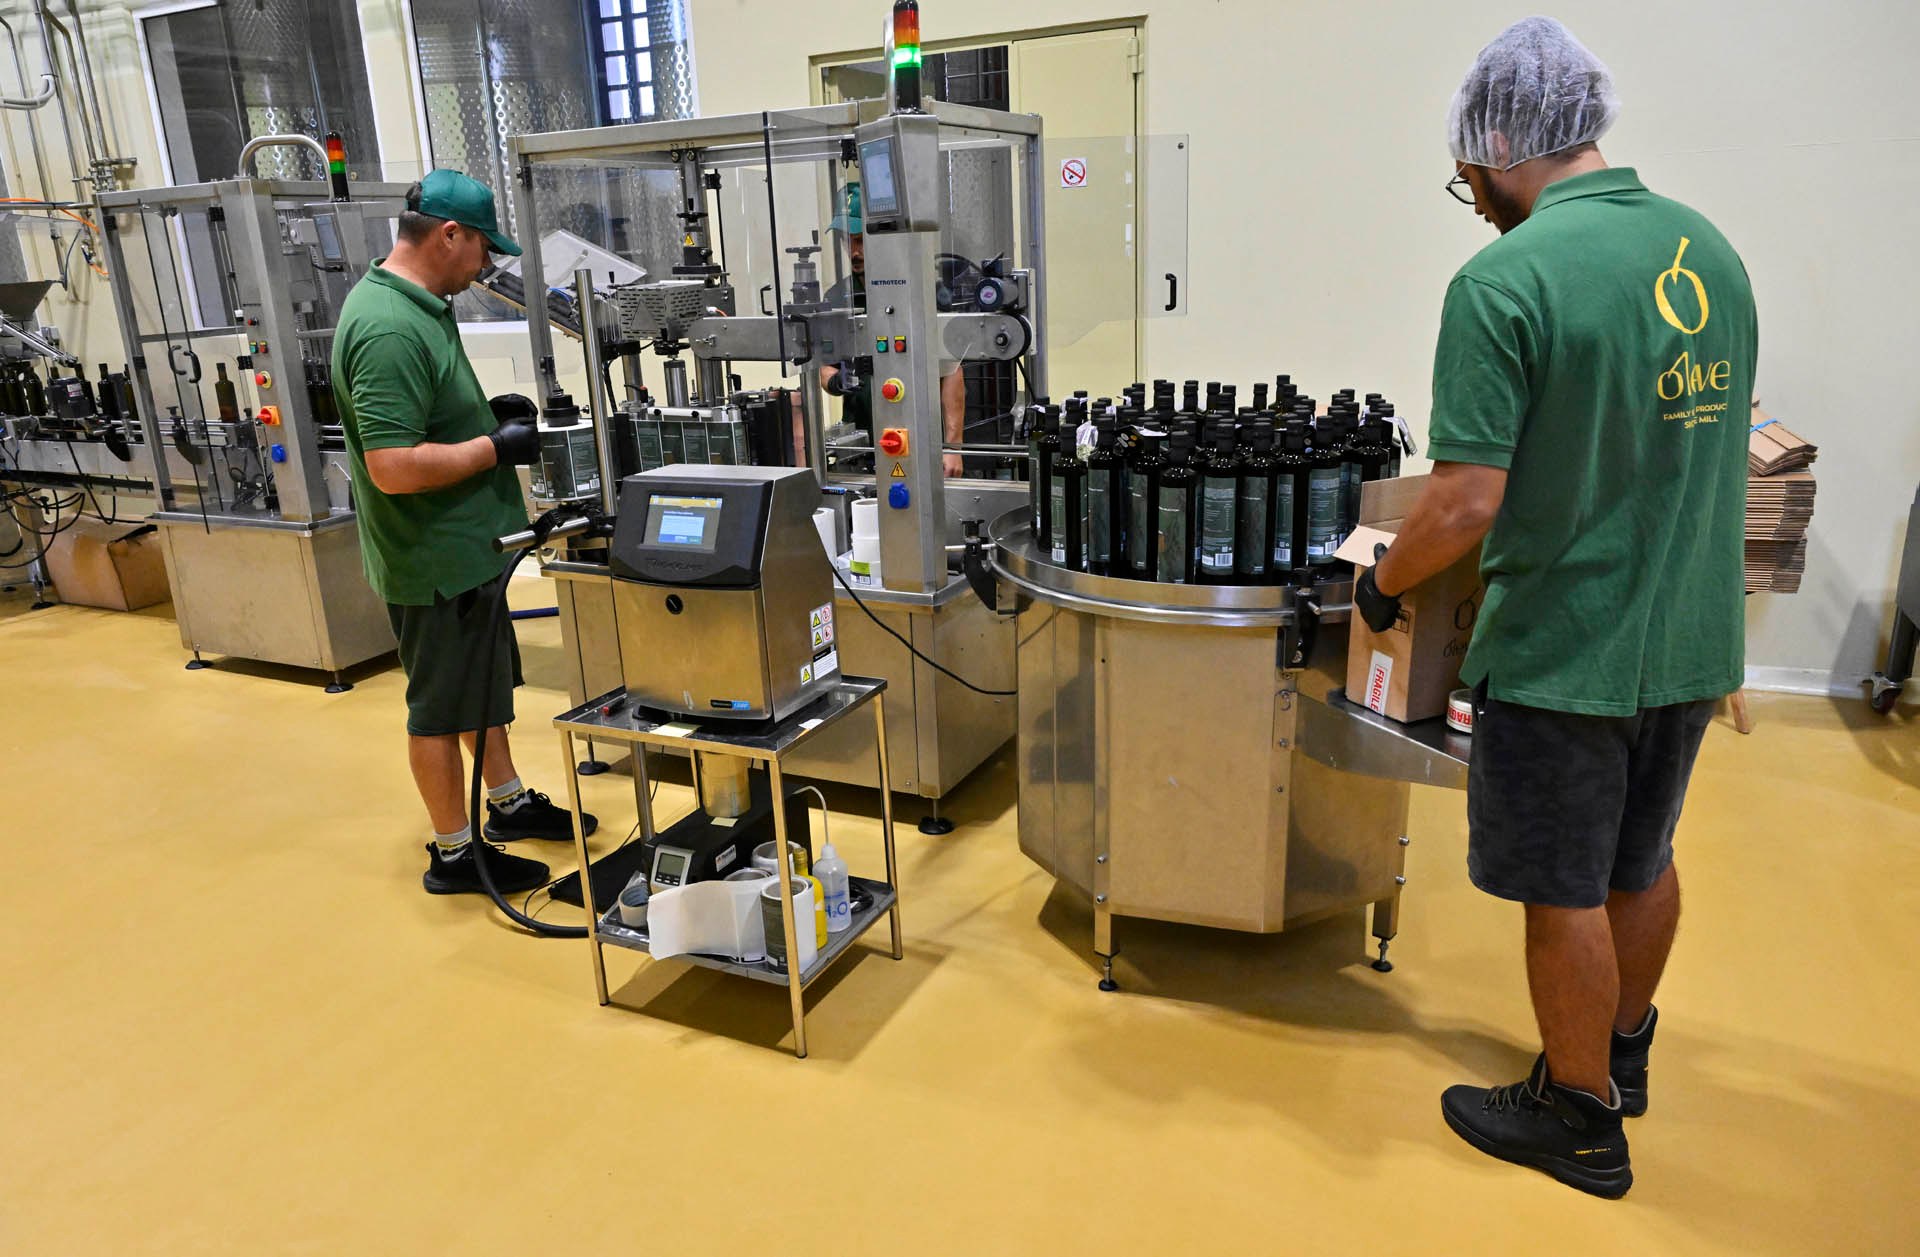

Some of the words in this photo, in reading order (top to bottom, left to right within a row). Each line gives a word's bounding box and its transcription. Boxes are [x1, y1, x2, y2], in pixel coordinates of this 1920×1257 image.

[1663, 410, 1690, 421] FAMILY
[1698, 415, 1719, 424] MILL
[1370, 667, 1385, 712] FRAGILE
